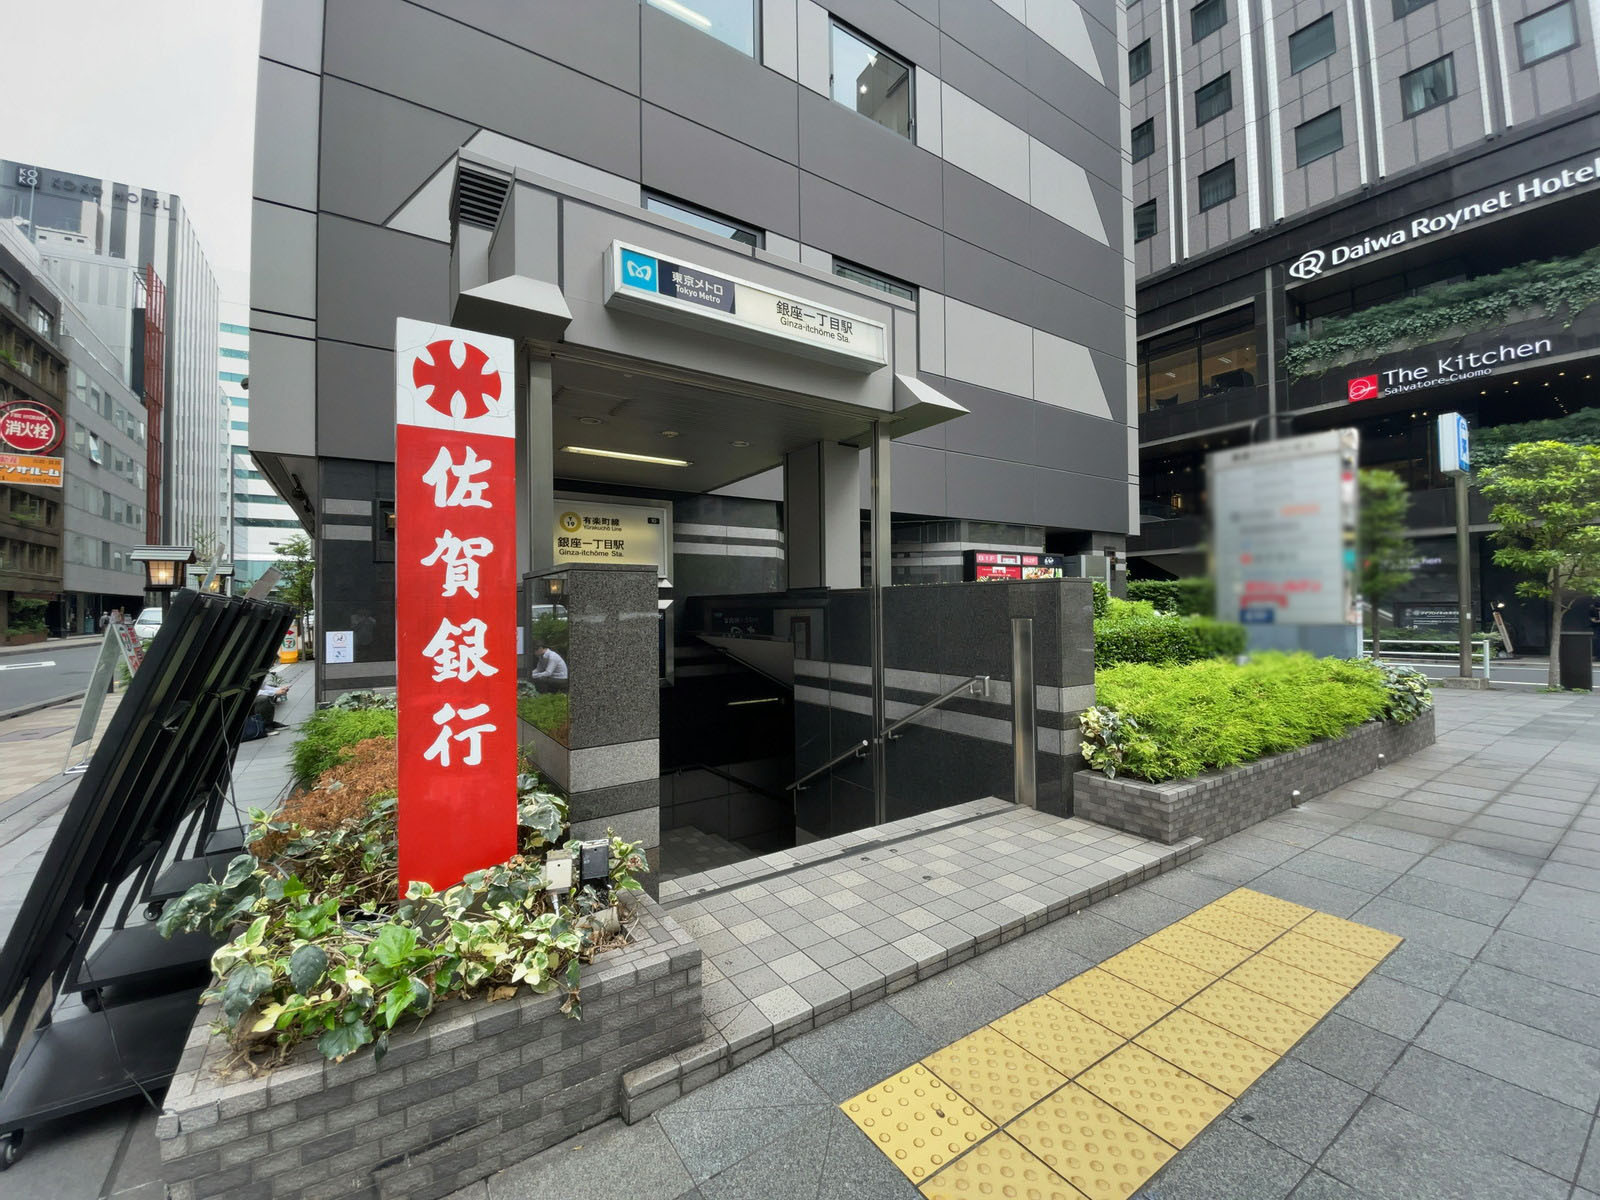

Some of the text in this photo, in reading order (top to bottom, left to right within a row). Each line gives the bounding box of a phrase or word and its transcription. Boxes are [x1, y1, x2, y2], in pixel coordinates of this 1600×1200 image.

[1331, 229, 1406, 266] Daiwa
[1411, 190, 1513, 232] Roynet
[671, 271, 724, 295] 東京メトロ
[675, 283, 721, 304] Tokyo Metro
[776, 300, 853, 335] 銀座一丁目駅
[1383, 339, 1551, 386] The Kitchen
[5, 419, 50, 440] 消火栓
[583, 516, 620, 526] 有楽町線
[557, 536, 624, 550] 銀座一丁目駅
[420, 445, 499, 767] 佐賀銀行
